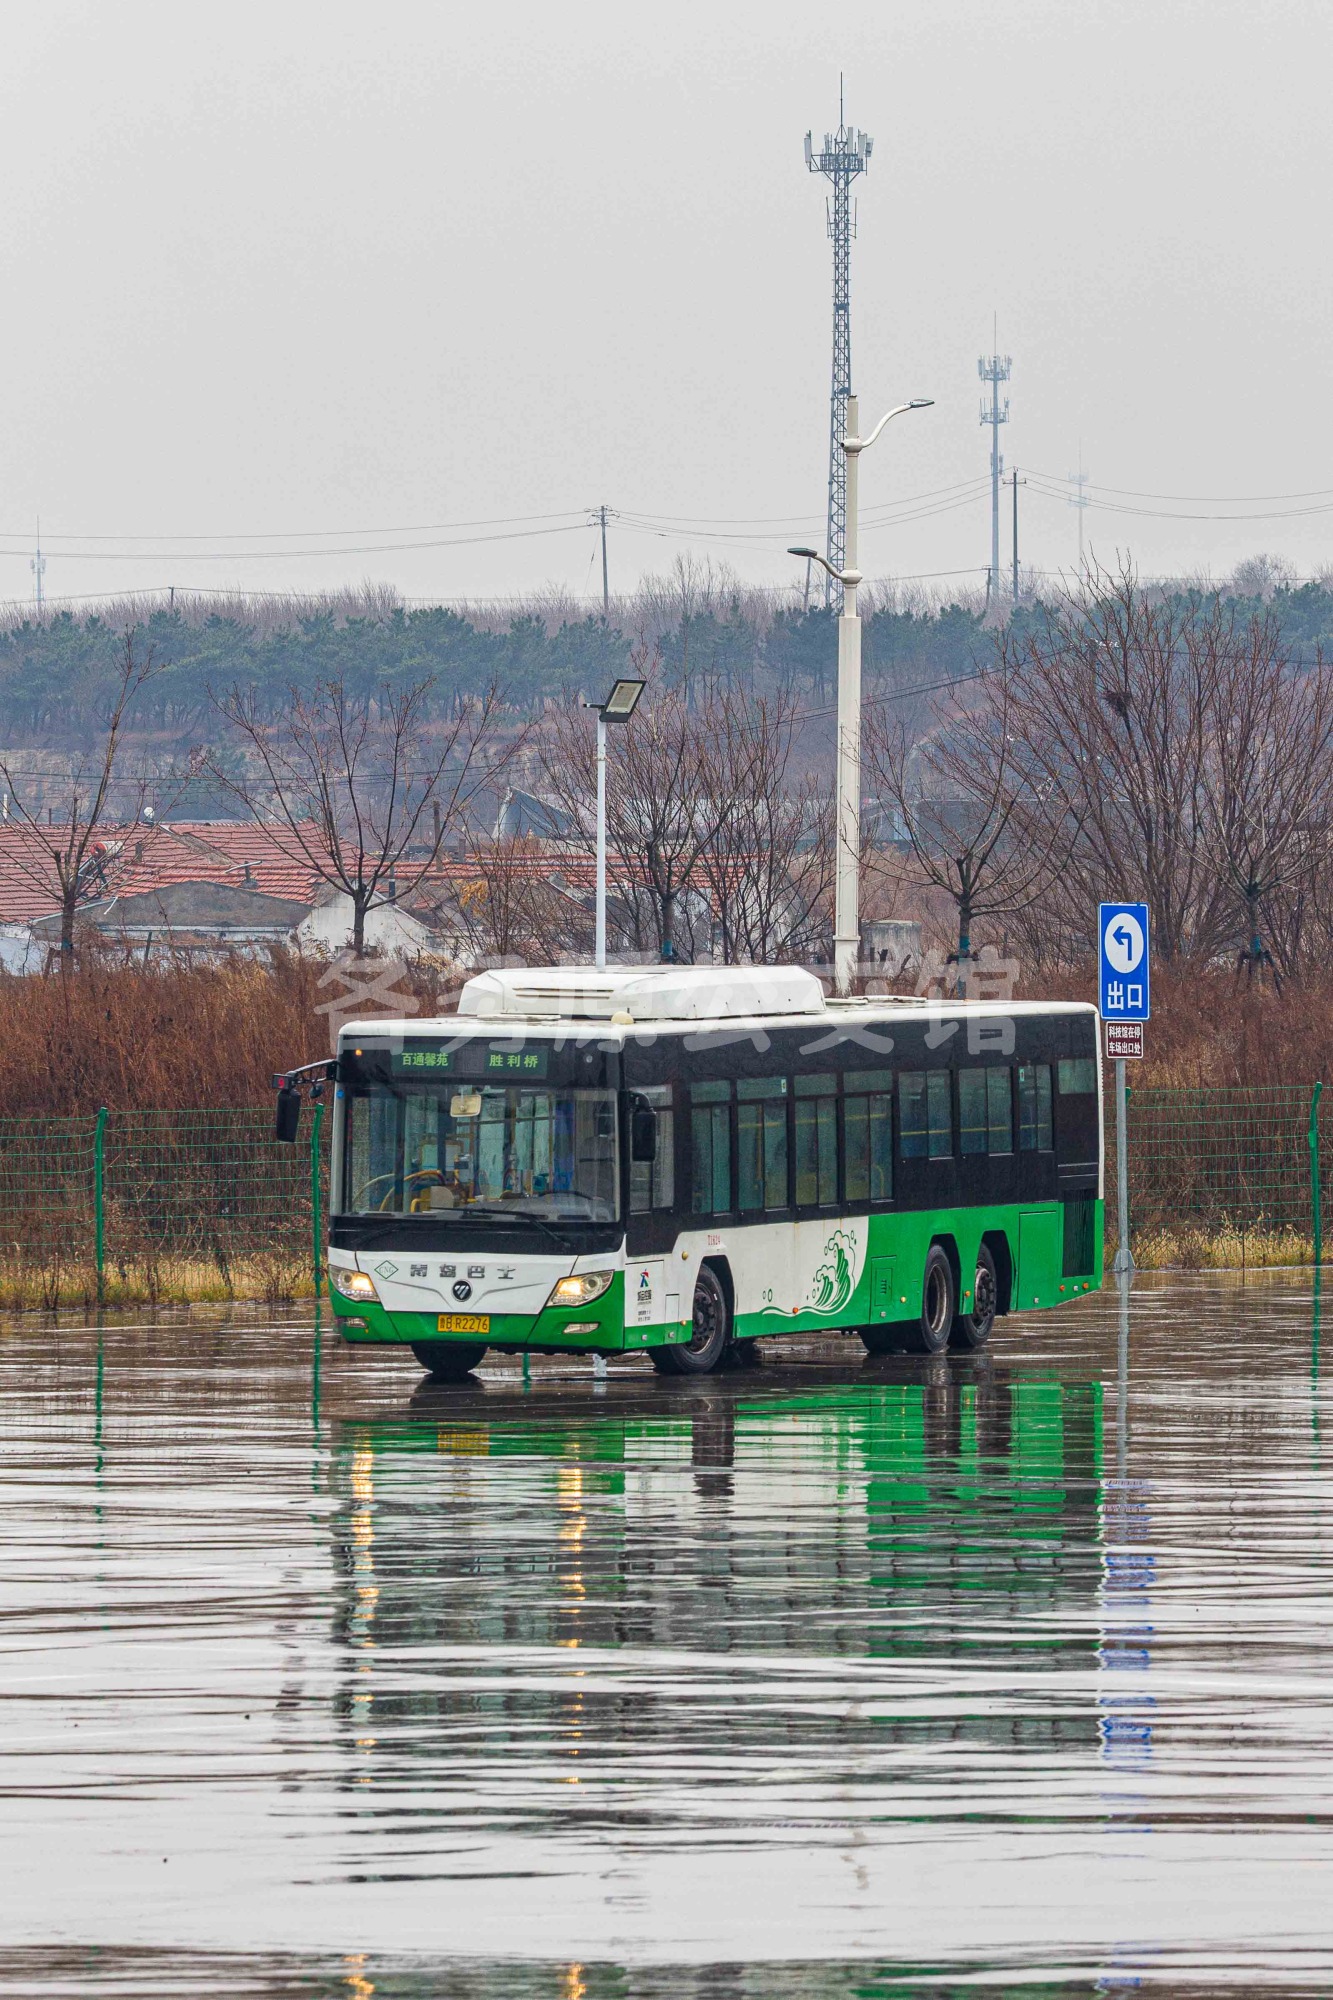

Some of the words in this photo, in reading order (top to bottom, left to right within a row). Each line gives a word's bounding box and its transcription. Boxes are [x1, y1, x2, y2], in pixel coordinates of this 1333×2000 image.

[1107, 980, 1143, 1010] 出口
[1108, 1041, 1141, 1054] 车场出口处
[401, 1052, 449, 1067] 百通馨苑
[489, 1054, 539, 1068] 胜利桥
[379, 1265, 394, 1275] CNG
